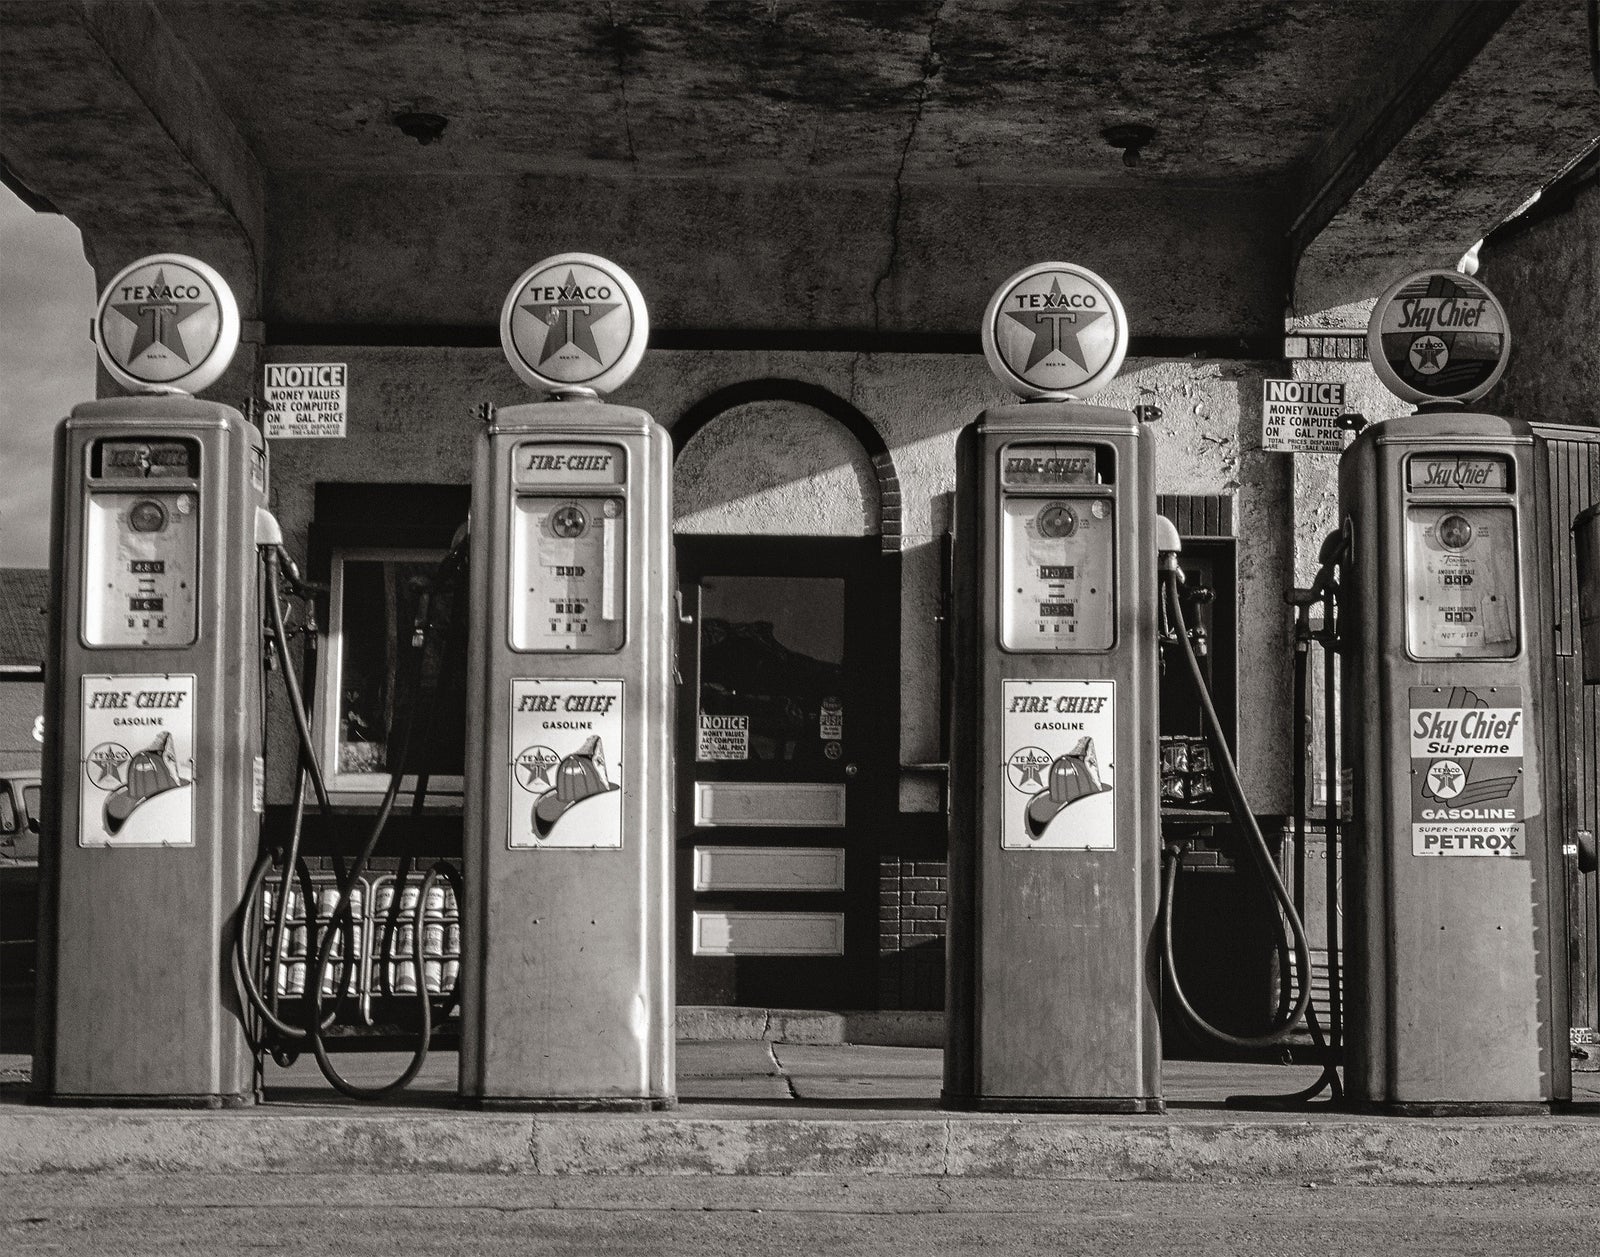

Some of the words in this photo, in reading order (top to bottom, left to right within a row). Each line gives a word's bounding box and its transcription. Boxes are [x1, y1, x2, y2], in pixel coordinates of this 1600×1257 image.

[121, 285, 200, 300] TEXACO
[531, 286, 611, 301] TEXACO
[1015, 294, 1096, 308] TEXACO
[1398, 299, 1436, 331] Sky
[1437, 299, 1486, 327] Chief
[271, 366, 341, 387] NOTICE
[271, 390, 303, 400] MONEY
[308, 390, 340, 400] VALUES
[1270, 382, 1341, 404] NOTICE
[270, 402, 286, 411] ARE
[290, 402, 339, 411] COMPUTED
[1270, 405, 1302, 415] MONEY
[1307, 406, 1339, 417] VALUES
[267, 413, 280, 423] ON
[296, 413, 315, 422] GAL.
[318, 413, 343, 422] PRICE
[1268, 416, 1285, 425] ARE
[1265, 427, 1279, 436] ON
[1295, 428, 1314, 438] GAL.
[1317, 430, 1342, 439] PRICE
[526, 455, 612, 471] FIRE-CHIEF
[1424, 463, 1452, 488] Sky
[1452, 462, 1494, 485] Chief
[89, 692, 131, 709] FIRE
[135, 692, 186, 709] CHIEF
[517, 695, 561, 712] FIRE
[565, 695, 616, 713] CHIEF
[1009, 696, 1052, 713] FIRE
[1056, 696, 1107, 714] CHIEF
[113, 717, 163, 726] GASOLINE
[702, 717, 745, 729] NOTICE
[1034, 722, 1084, 730] GASOLINE
[1413, 711, 1458, 743] Sky
[1460, 711, 1521, 739] Chief
[94, 751, 127, 759] TEXACO
[1427, 742, 1509, 756] Su-preme
[1421, 808, 1516, 820] GASOLINE
[1424, 834, 1517, 850] PETROX
